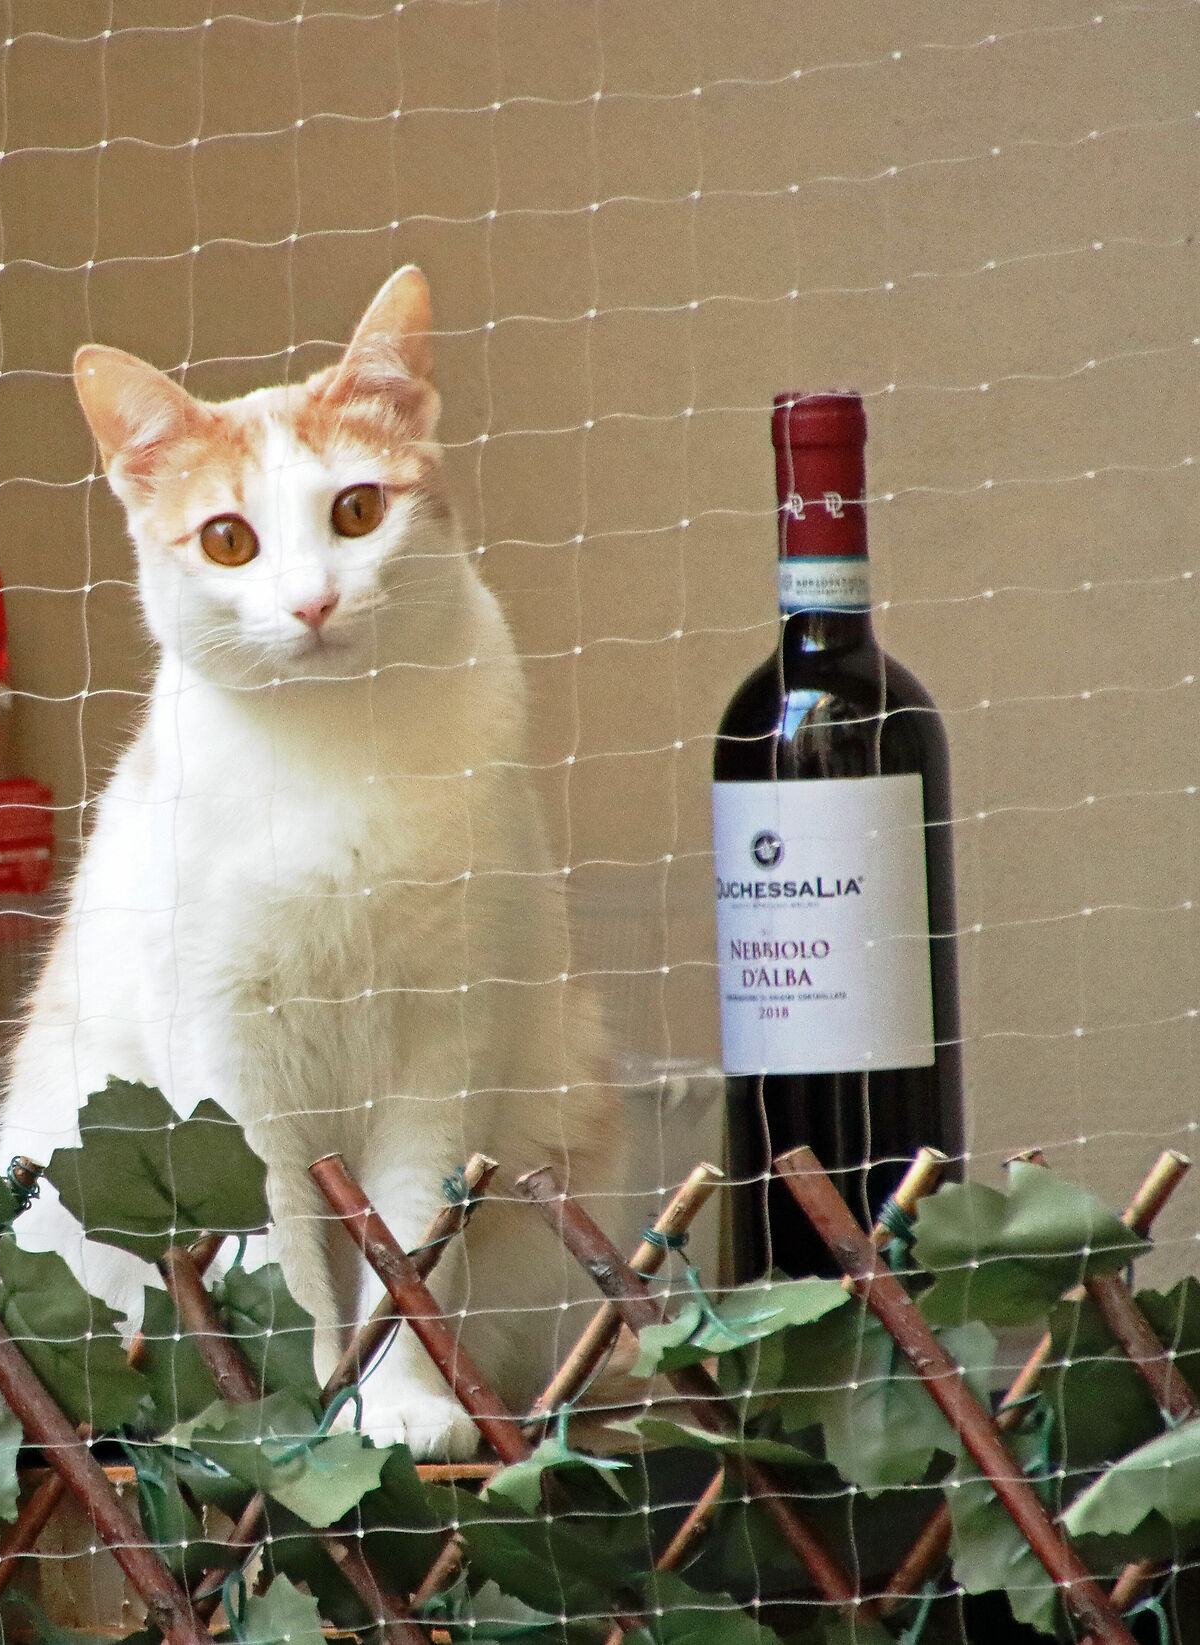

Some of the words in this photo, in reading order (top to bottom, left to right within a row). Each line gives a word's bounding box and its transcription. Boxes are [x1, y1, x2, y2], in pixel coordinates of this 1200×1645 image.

[731, 939, 830, 960] NEBBIOLO
[742, 967, 813, 988] D'ALBA
[759, 1006, 789, 1020] 2018
